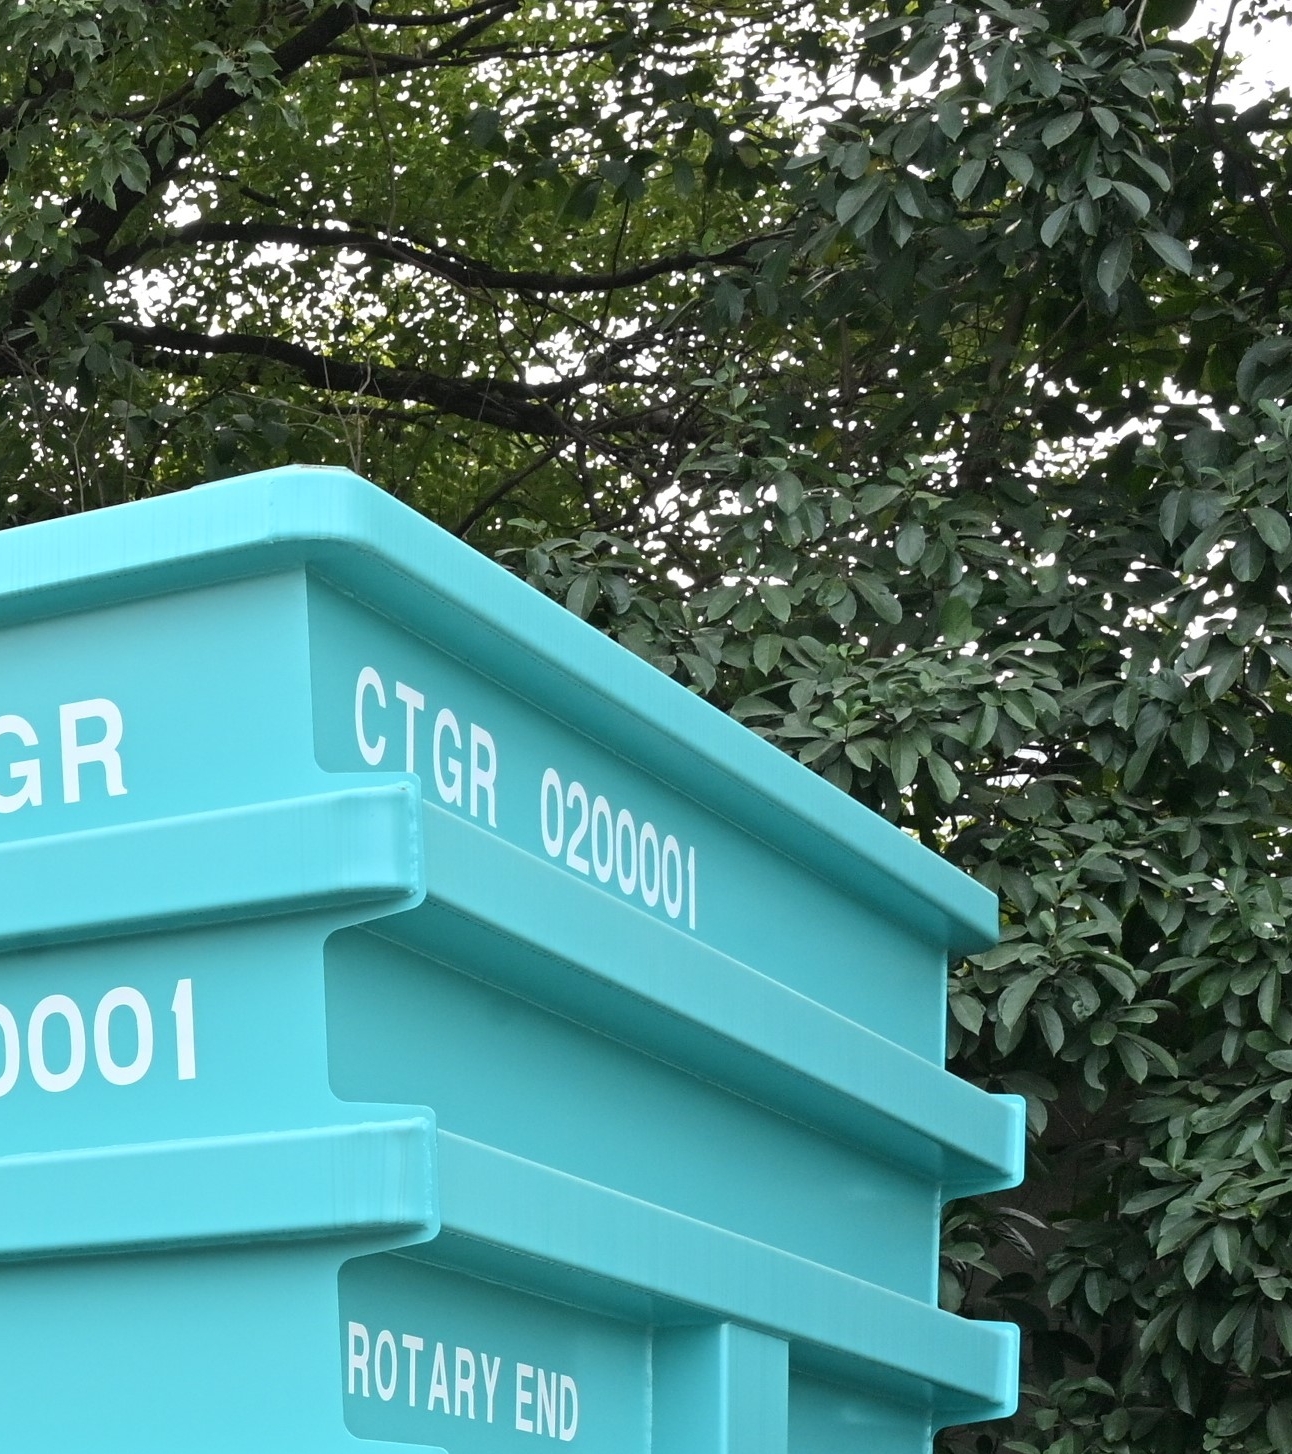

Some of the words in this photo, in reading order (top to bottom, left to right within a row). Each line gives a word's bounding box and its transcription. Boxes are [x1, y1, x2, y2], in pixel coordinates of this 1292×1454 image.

[355, 666, 498, 828] CTGR
[540, 767, 696, 931] 0200001
[348, 1320, 501, 1424] ROTARY
[515, 1362, 579, 1442] END
